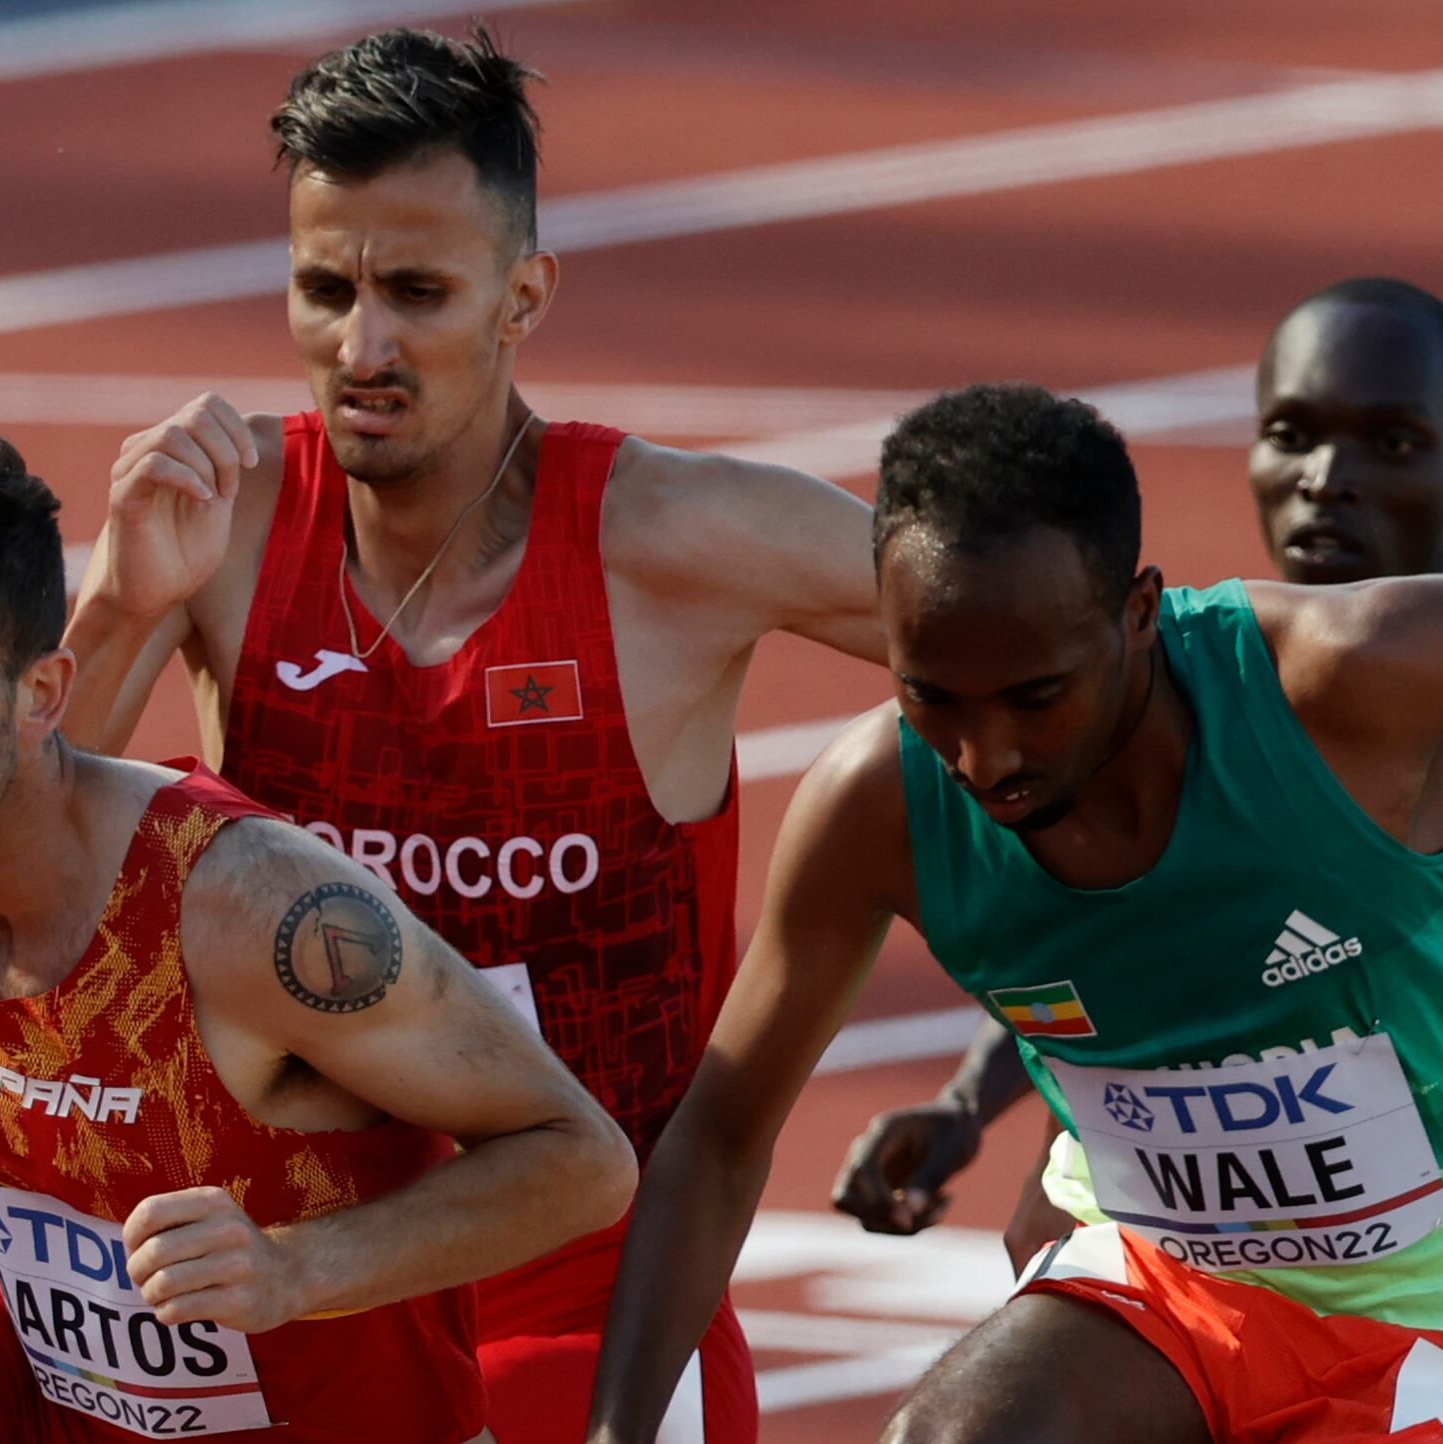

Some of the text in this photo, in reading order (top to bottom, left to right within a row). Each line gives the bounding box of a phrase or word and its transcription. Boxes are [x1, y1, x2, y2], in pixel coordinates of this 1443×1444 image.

[1262, 935, 1363, 987] adidas
[1145, 1063, 1356, 1134] TDK
[1134, 1135, 1365, 1212] WALE
[1158, 1221, 1398, 1268] OREGON22
